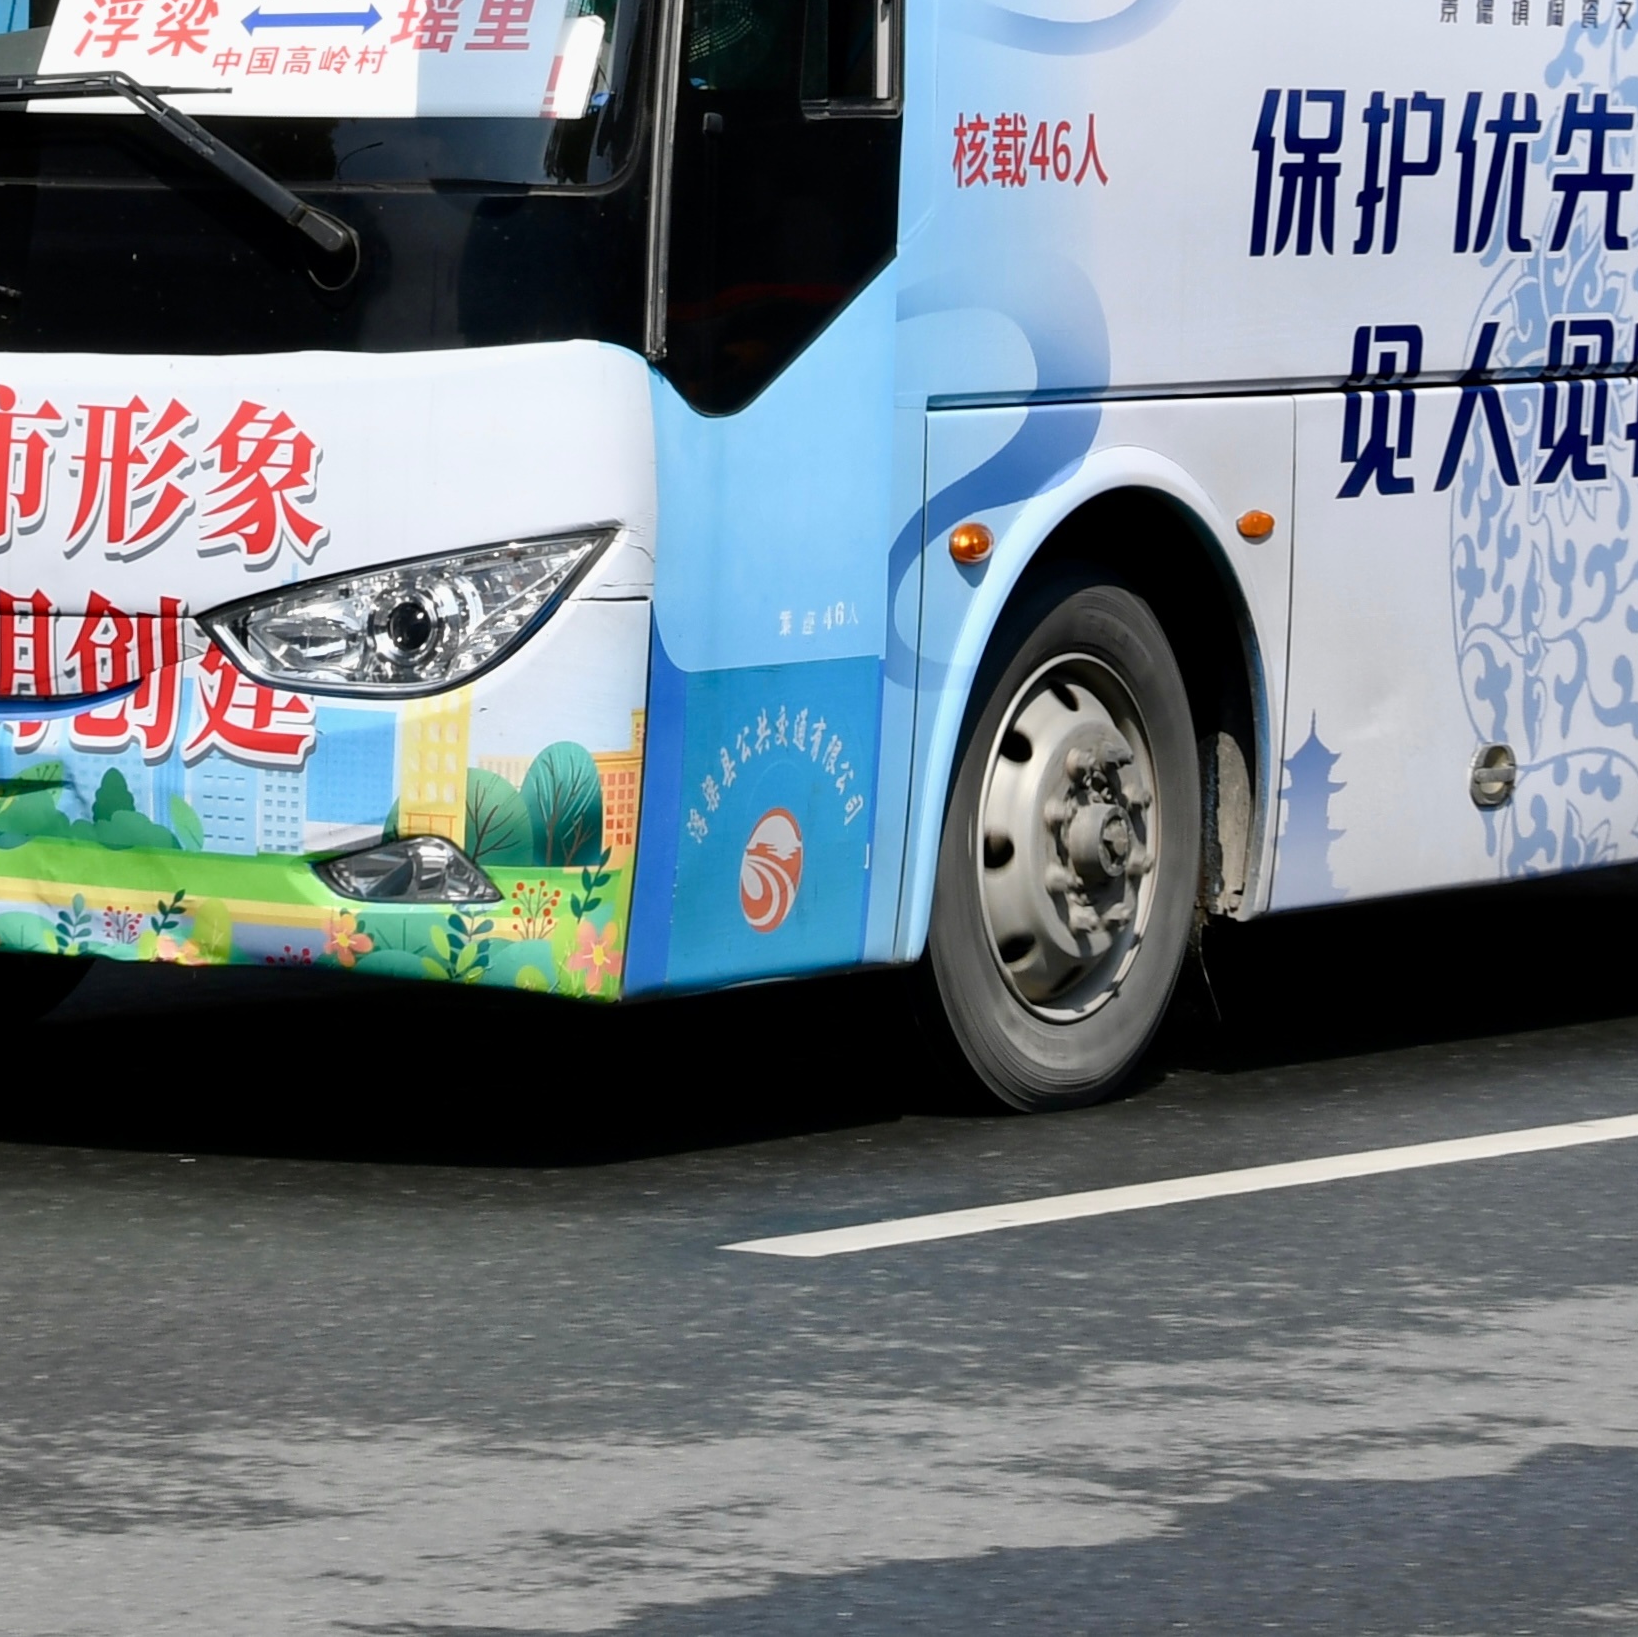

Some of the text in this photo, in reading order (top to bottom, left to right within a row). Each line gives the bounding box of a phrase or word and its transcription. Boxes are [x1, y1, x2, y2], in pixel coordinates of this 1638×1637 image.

[211, 45, 389, 76] 中国高岭村
[952, 112, 1109, 189] 核载46人
[686, 704, 864, 844] 浮梁县公共交通有限公司
